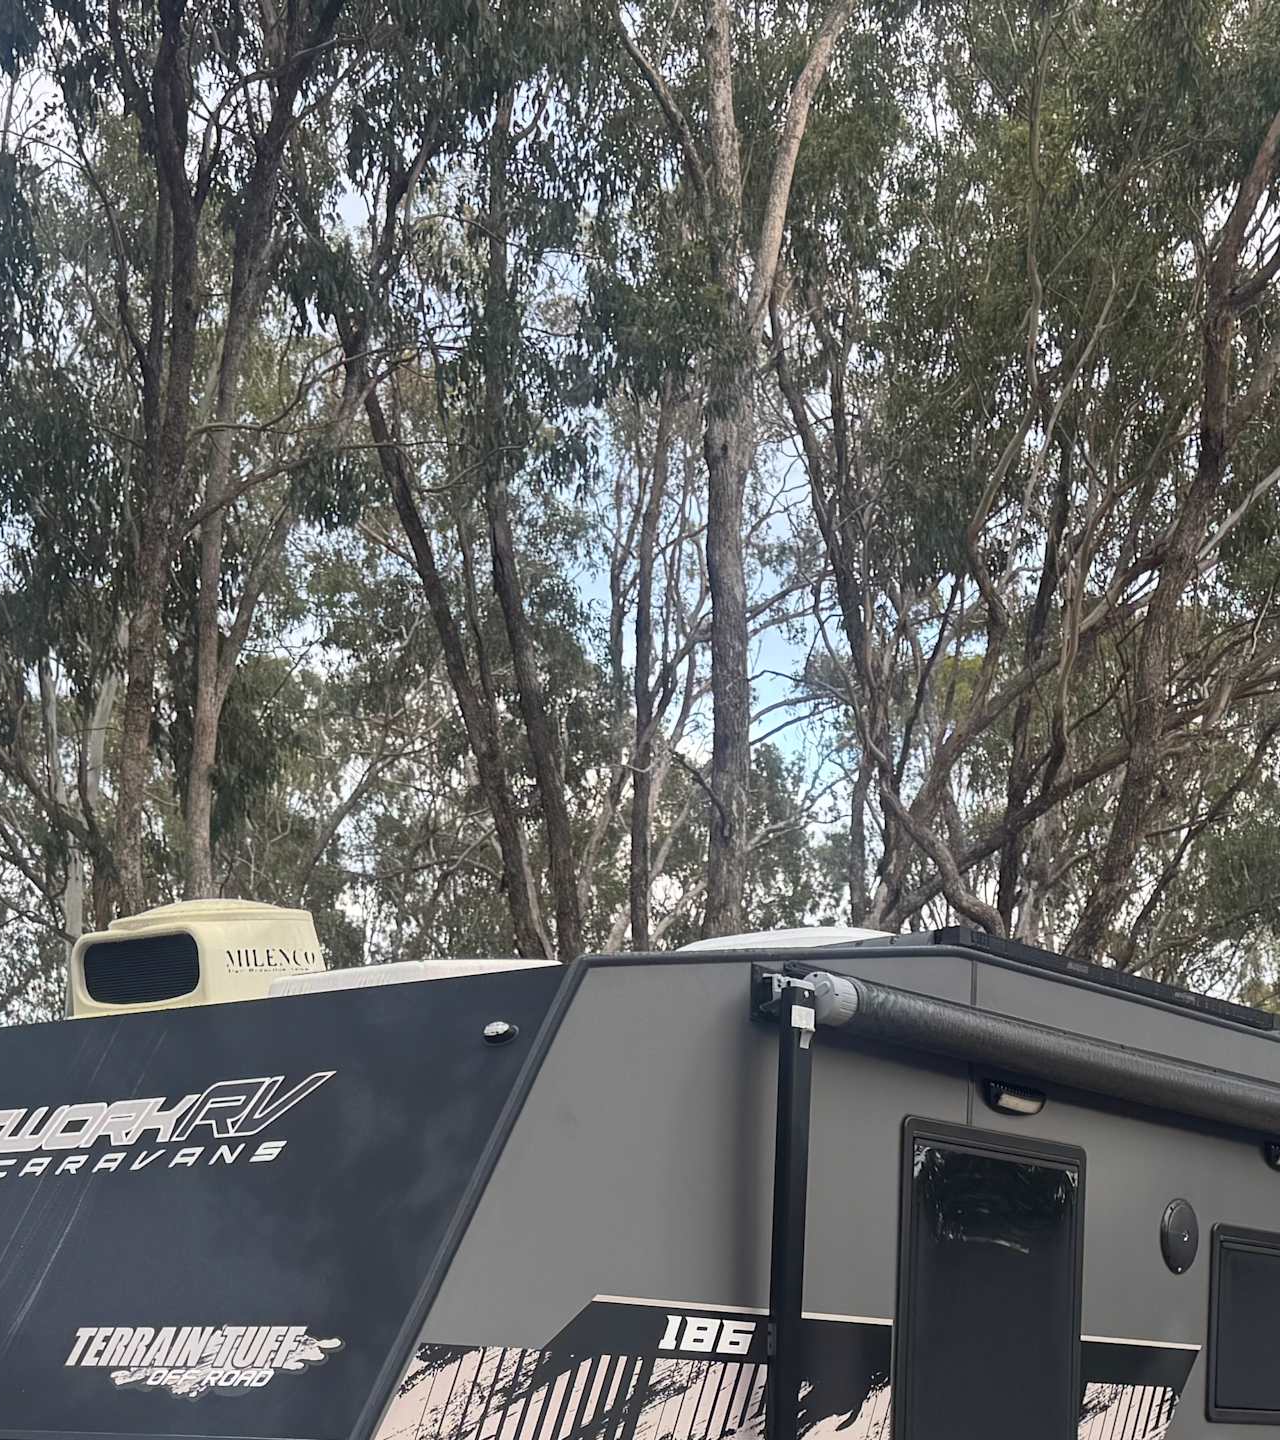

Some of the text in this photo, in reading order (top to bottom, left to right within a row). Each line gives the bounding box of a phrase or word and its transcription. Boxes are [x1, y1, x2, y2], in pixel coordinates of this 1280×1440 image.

[226, 948, 315, 968] MILENCO
[65, 1325, 308, 1368] TERRAIN TUFF
[658, 1314, 757, 1355] 186
[146, 1369, 275, 1387] OFF ROAD
